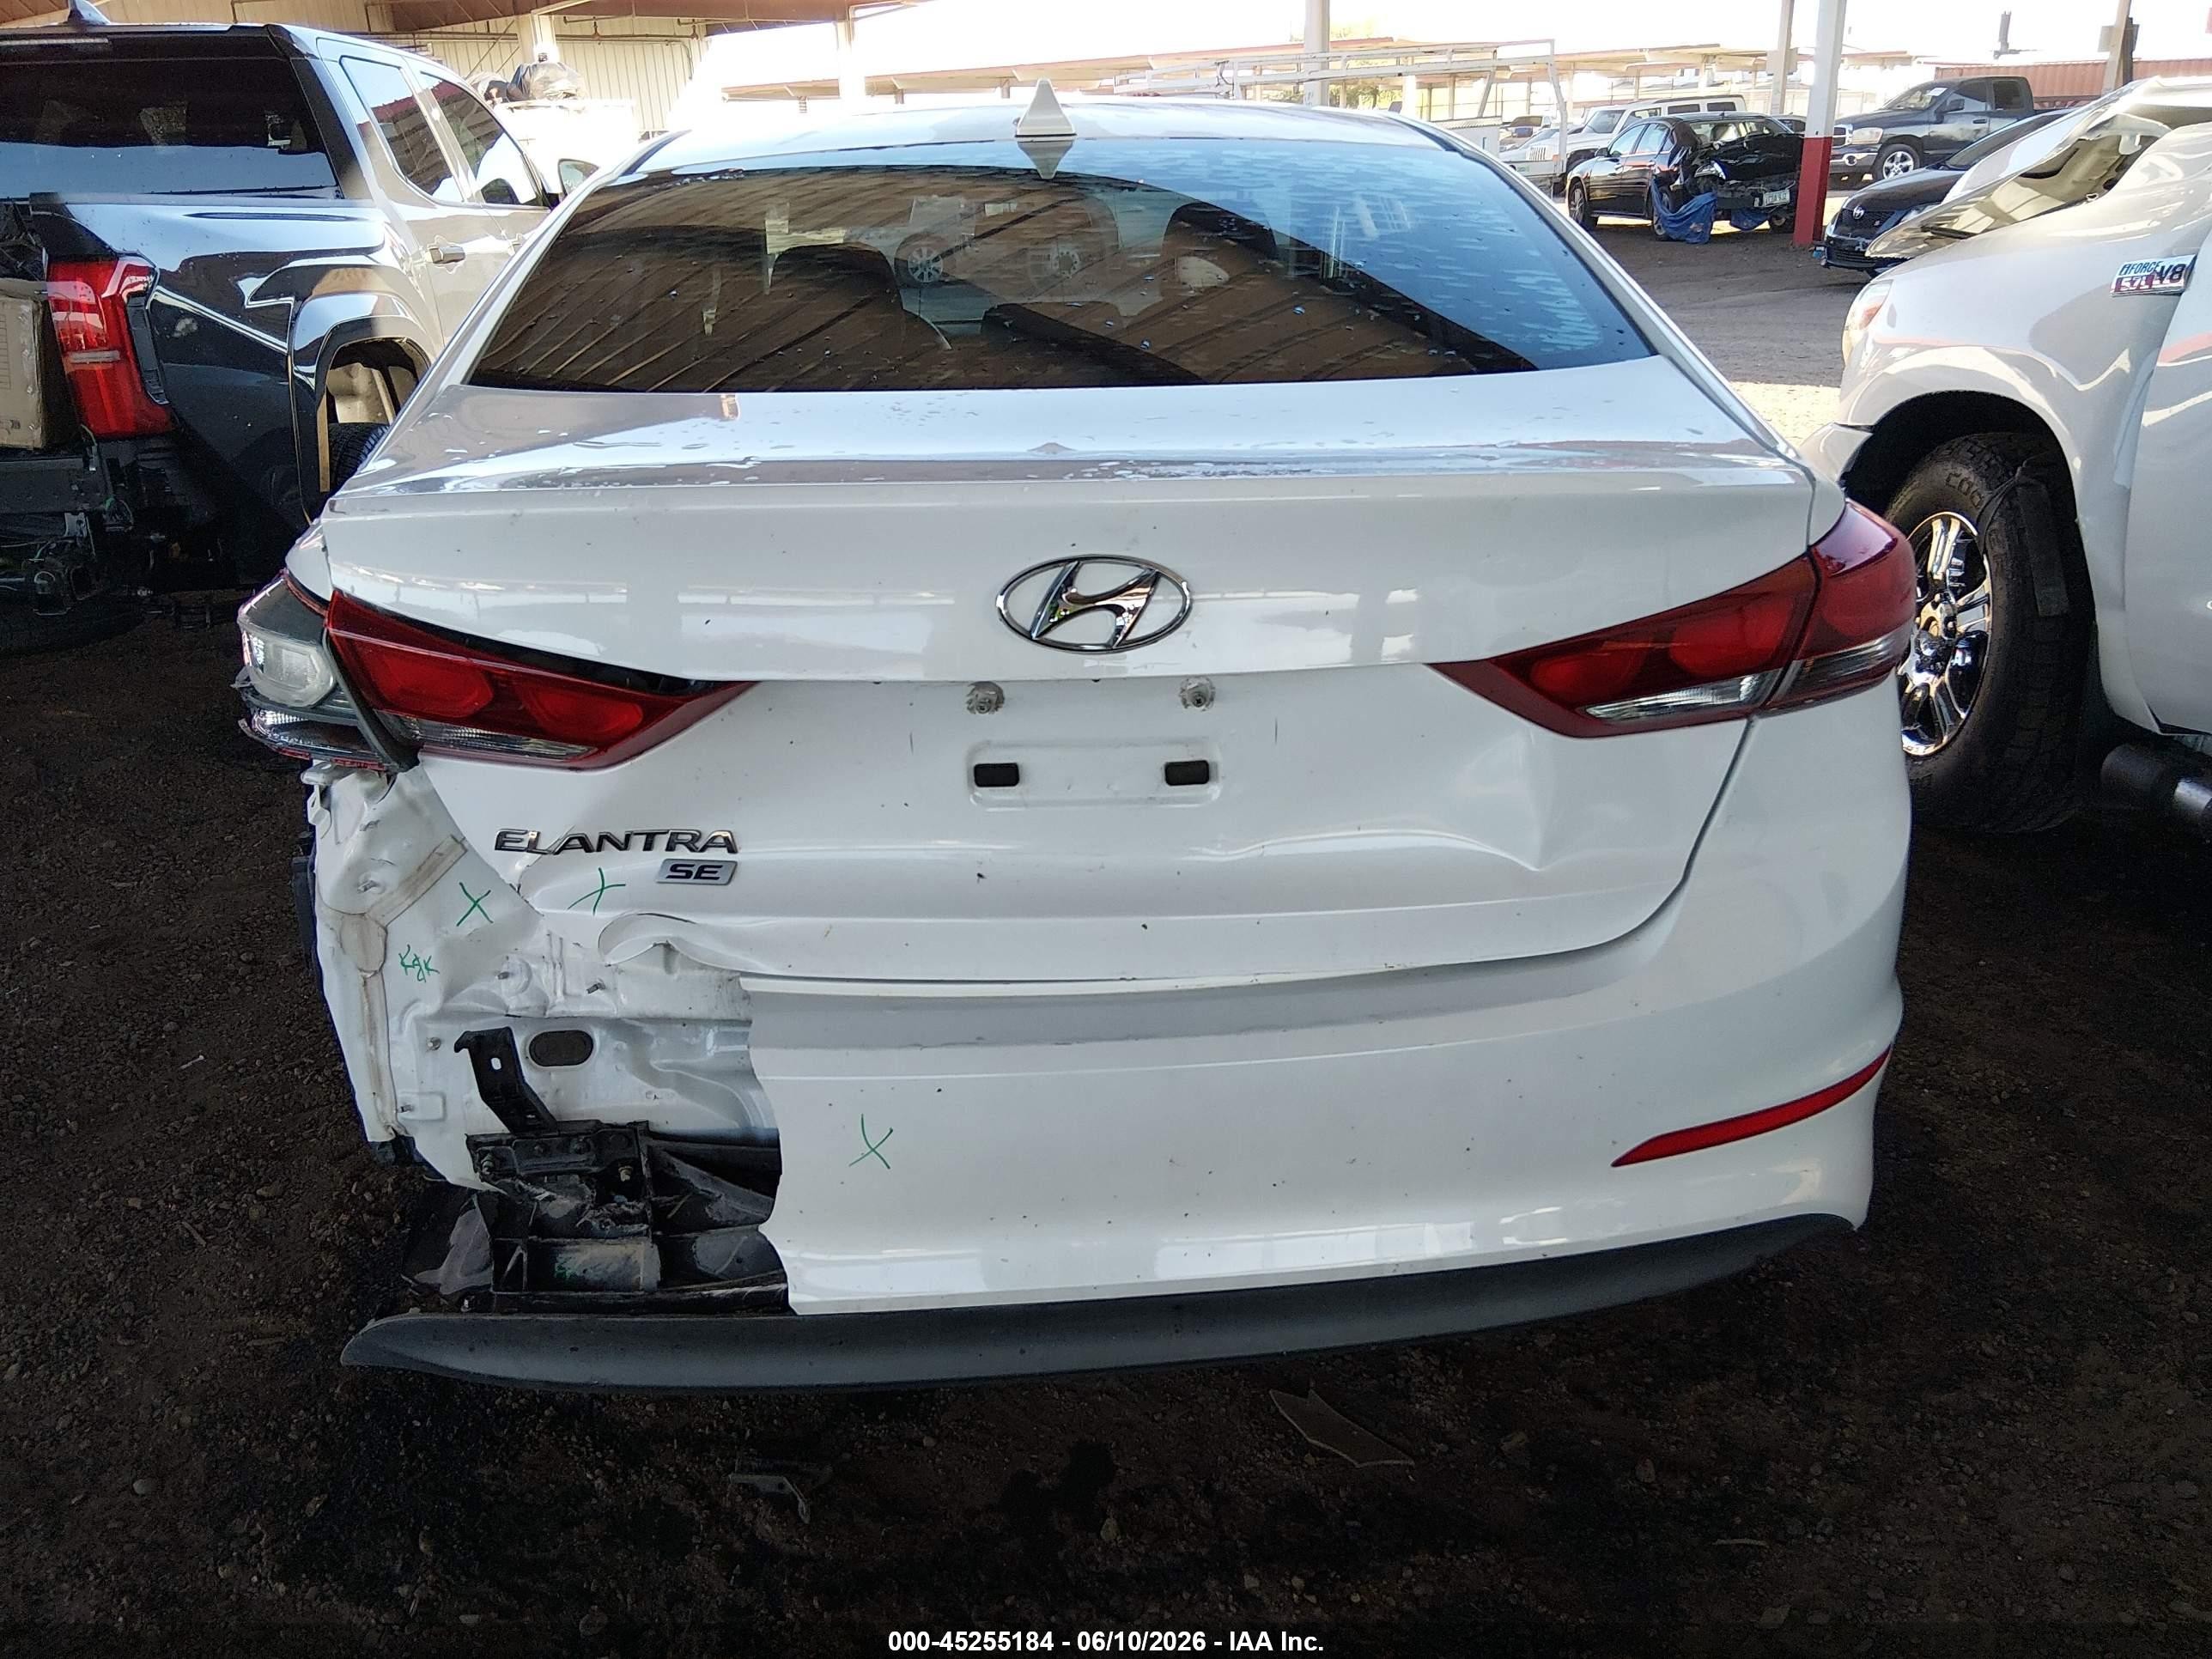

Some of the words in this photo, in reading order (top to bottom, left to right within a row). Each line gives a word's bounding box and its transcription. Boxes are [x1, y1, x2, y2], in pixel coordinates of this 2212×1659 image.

[2158, 263, 2186, 283] V8
[494, 828, 739, 855] ELANTRA
[665, 862, 724, 881] SE
